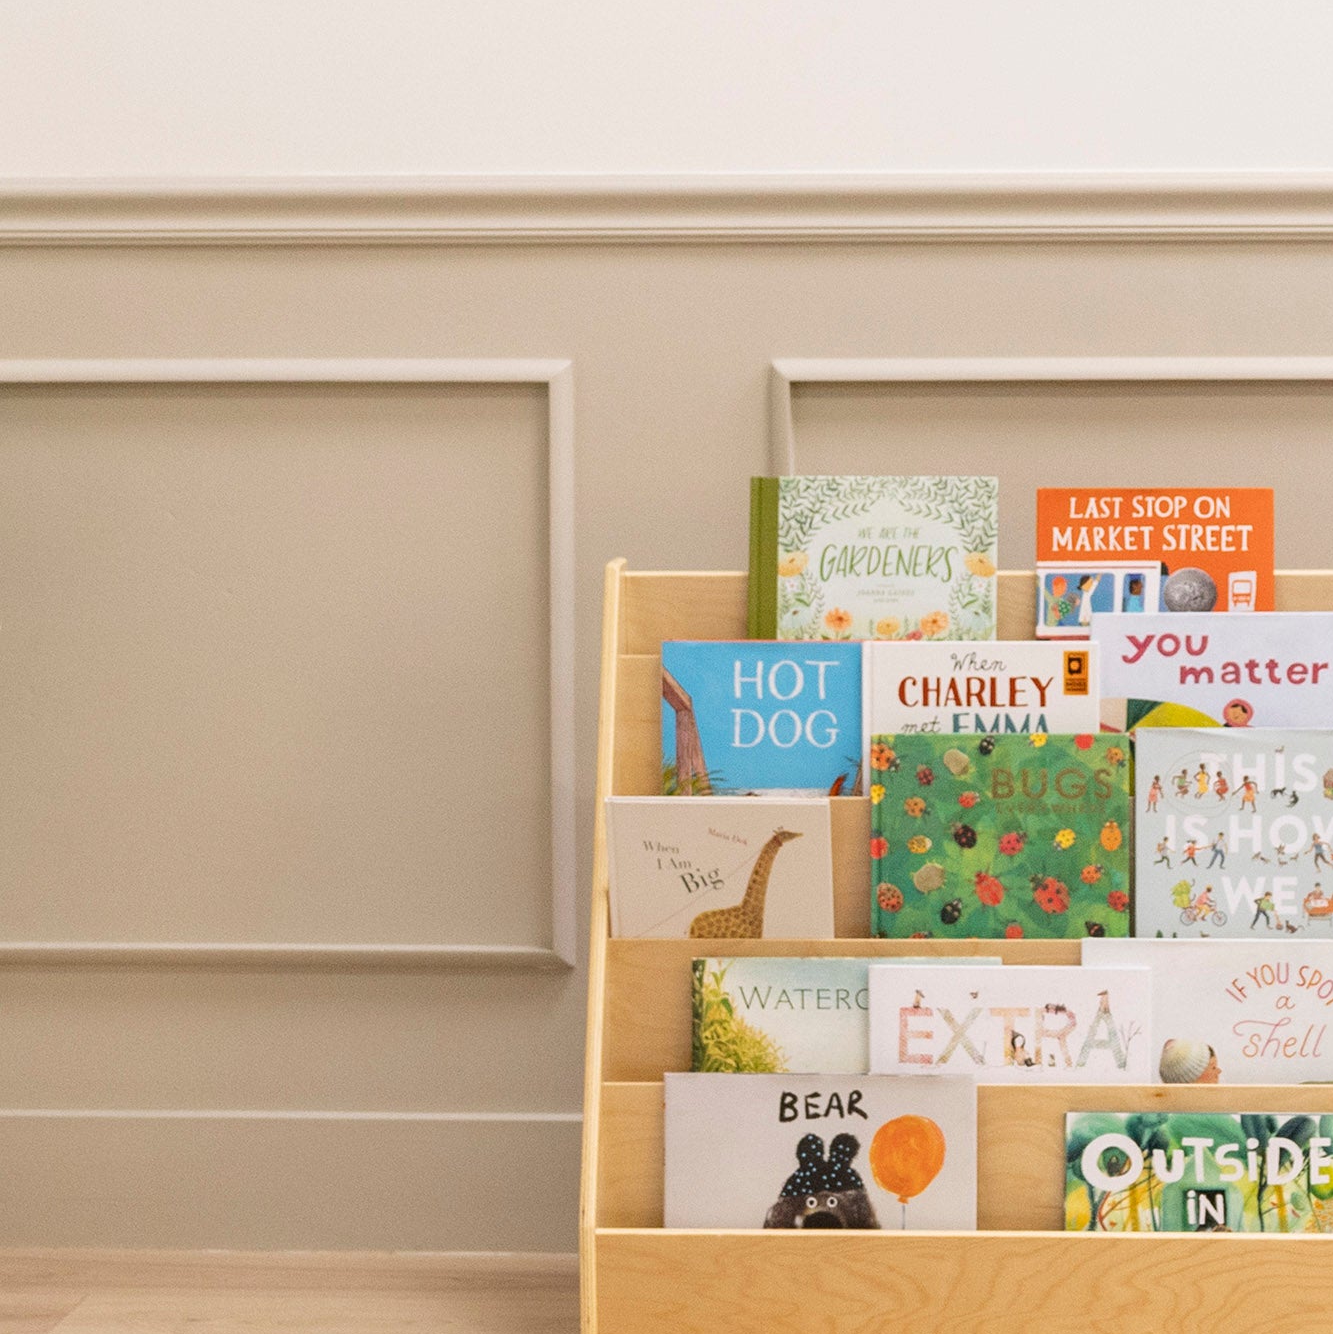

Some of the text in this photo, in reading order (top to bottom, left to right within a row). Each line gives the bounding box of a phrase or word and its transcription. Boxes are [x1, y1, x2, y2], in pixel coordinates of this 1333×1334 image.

[1069, 495, 1230, 518] LAST STOP ON
[1051, 524, 1253, 551] MARKET STREET
[819, 543, 959, 583] GARDENERS
[951, 651, 1007, 672] When
[1121, 633, 1209, 664] you
[734, 660, 840, 700] HOT
[1180, 659, 1329, 684] matter
[898, 676, 1054, 707] CHARLEY
[731, 709, 840, 748] DOG
[901, 715, 941, 733] met
[991, 768, 1112, 799] BUGS
[1200, 752, 1317, 793] THIS
[643, 840, 680, 854] When
[1165, 814, 1209, 854] IS
[657, 858, 662, 870] I
[680, 868, 725, 894] Big
[1221, 875, 1299, 916] WE
[1225, 978, 1248, 1004] IF
[1246, 962, 1290, 988] YOU
[1275, 995, 1296, 1011] a
[898, 1005, 1127, 1069] EXTRA
[1232, 1017, 1327, 1059] shell
[778, 1090, 868, 1123] BEAR
